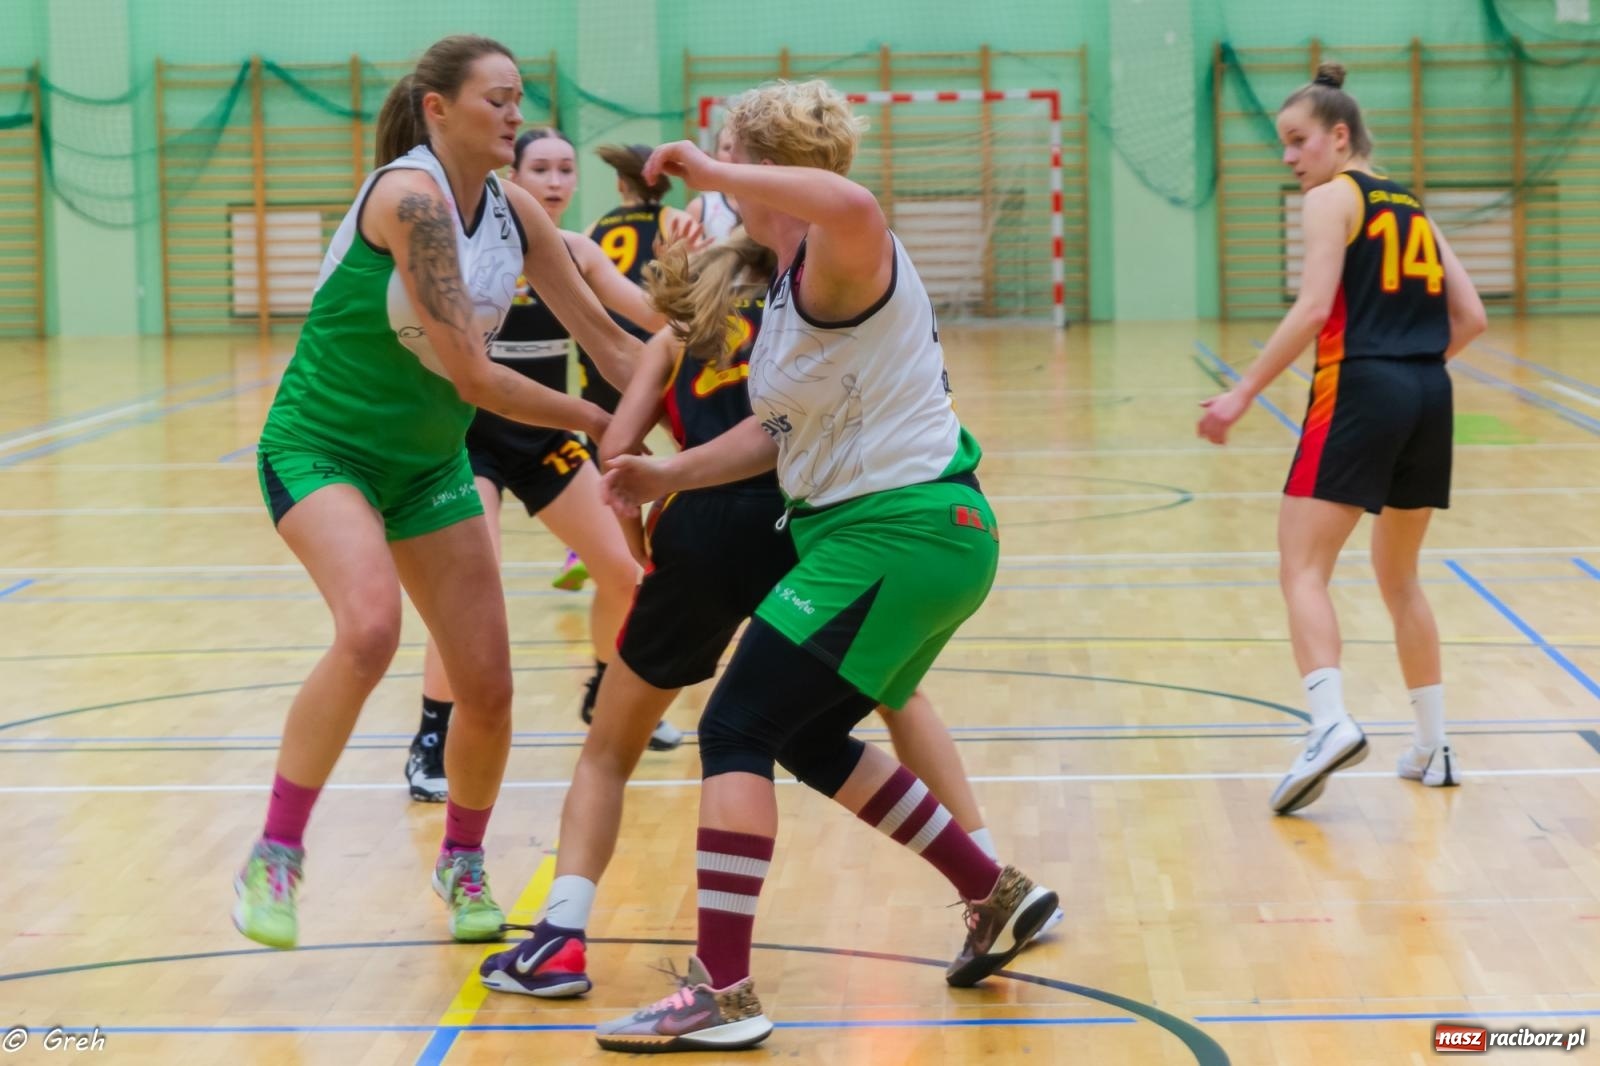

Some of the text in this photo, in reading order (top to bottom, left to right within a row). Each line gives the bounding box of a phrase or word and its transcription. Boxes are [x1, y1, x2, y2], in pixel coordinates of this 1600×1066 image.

[600, 225, 638, 276] 9
[1366, 208, 1445, 295] 14
[541, 439, 591, 476] 13
